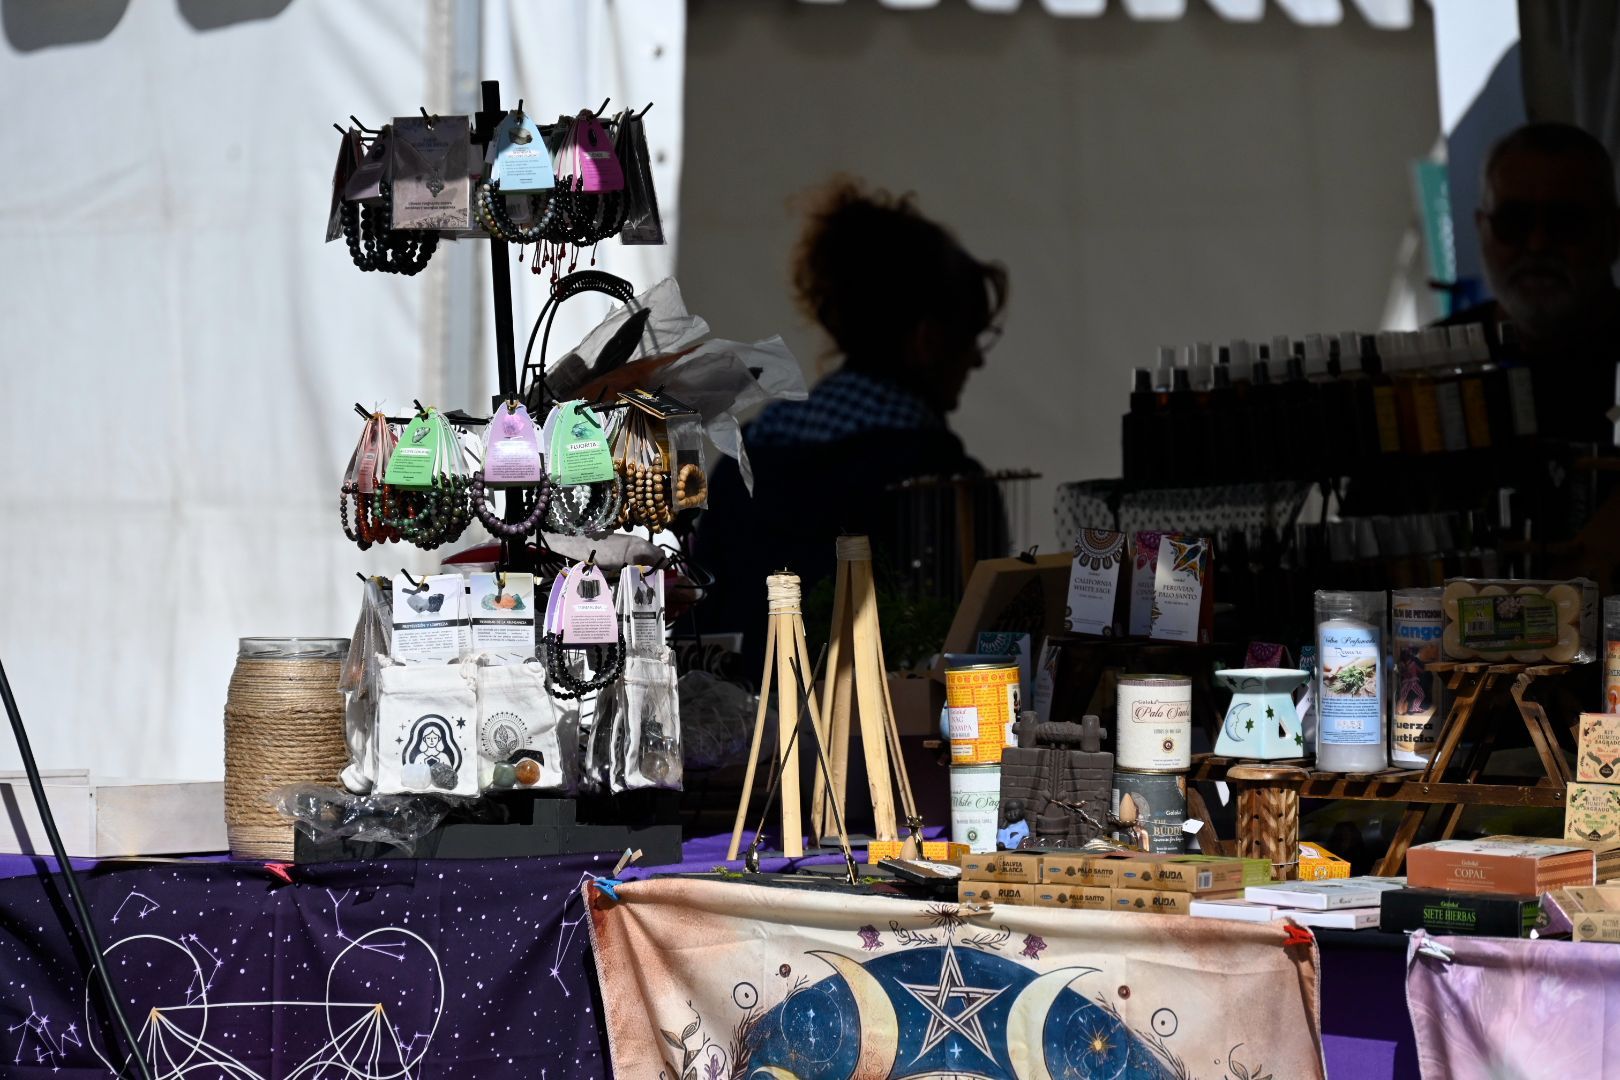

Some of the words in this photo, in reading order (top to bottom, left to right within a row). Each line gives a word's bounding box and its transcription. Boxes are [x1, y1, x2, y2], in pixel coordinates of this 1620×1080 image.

[1074, 577, 1112, 588] CALIFORNIA
[1073, 584, 1092, 594] WHITE
[1094, 586, 1111, 595] SAGE
[1163, 584, 1195, 593] PERUVIAN
[1158, 591, 1173, 600] PALO
[1175, 592, 1198, 601] SANTO
[1135, 705, 1164, 721] Palo
[1093, 868, 1114, 876] SANTO
[1159, 870, 1183, 880] RUDA
[1454, 868, 1486, 879] COPAL
[998, 889, 1021, 898] RUDA
[1069, 894, 1084, 902] PALO
[1084, 894, 1105, 902] SANTO
[1152, 896, 1176, 907] RUDA
[1424, 909, 1444, 920] SIETE
[1444, 909, 1477, 922] HIERBAS
